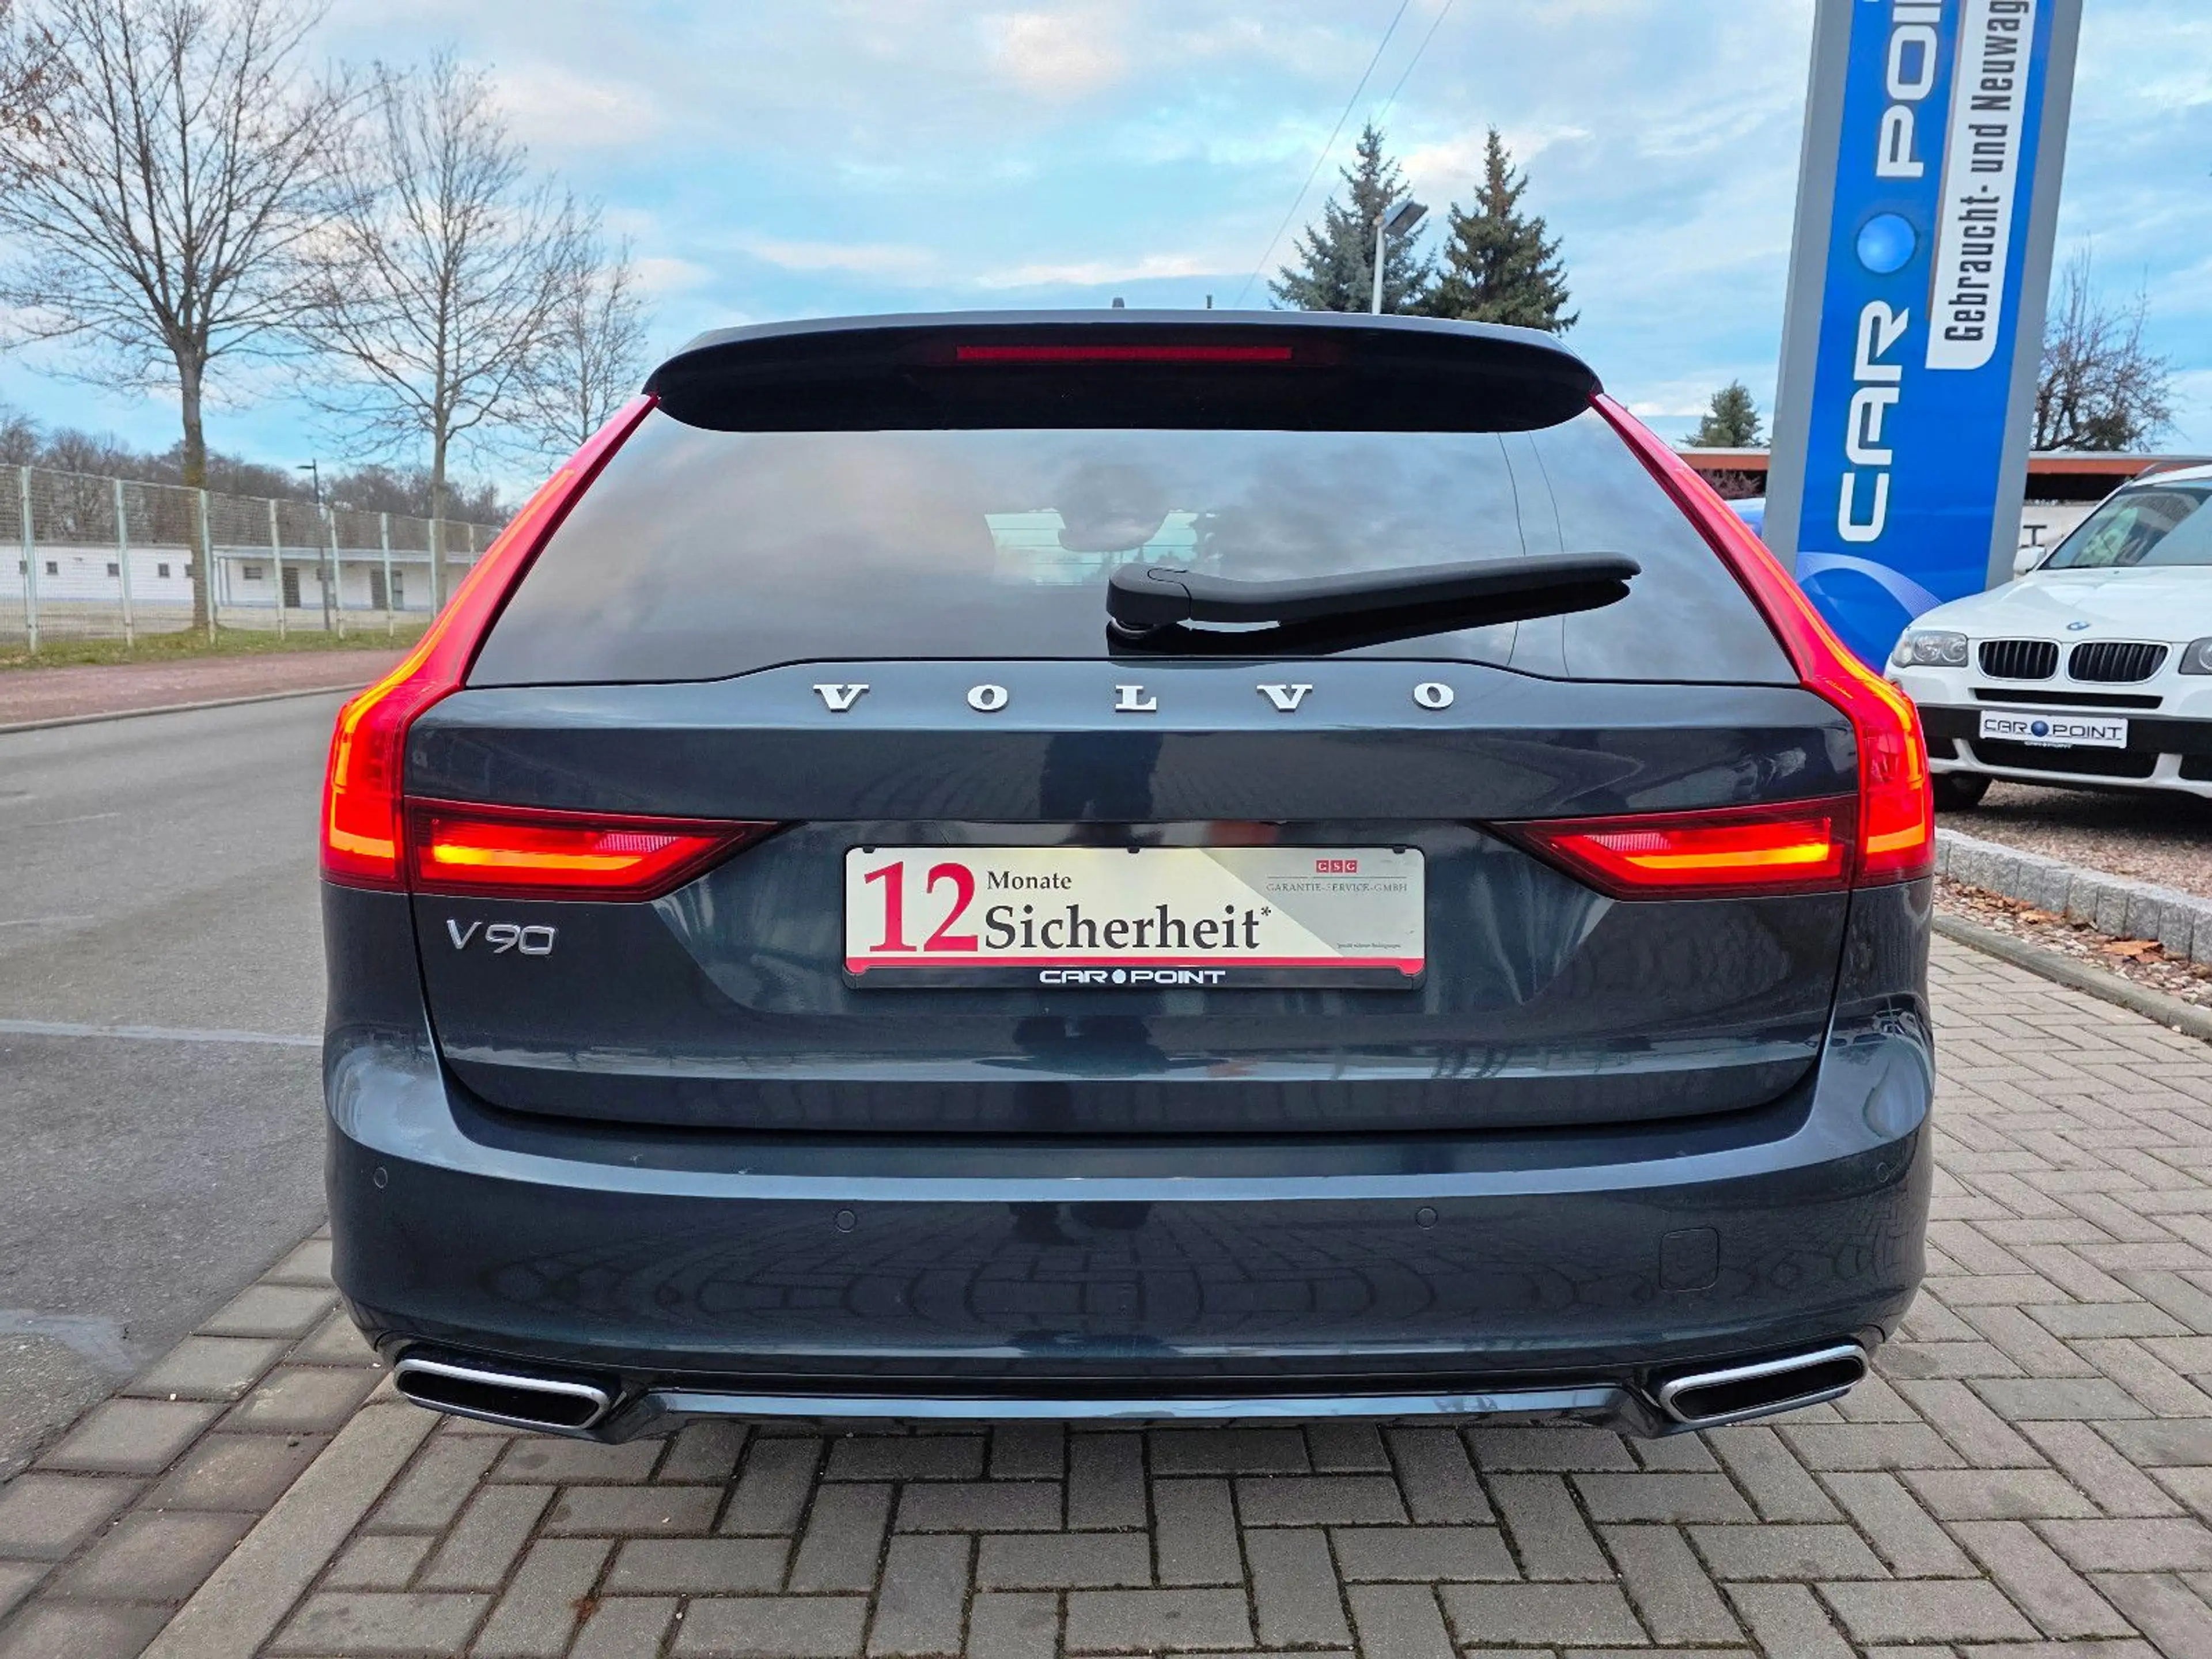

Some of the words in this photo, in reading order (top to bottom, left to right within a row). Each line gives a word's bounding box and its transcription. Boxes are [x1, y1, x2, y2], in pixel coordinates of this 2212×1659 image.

[1968, 123, 2008, 173] und
[1838, 300, 1910, 542] CAR
[1876, 0, 1942, 178] POI
[1945, 184, 2000, 342] Gebraucht-
[813, 683, 1454, 712] VOLVO
[1984, 719, 2028, 733] CAR
[2052, 724, 2123, 739] POINT
[987, 871, 1072, 891] Monate
[1317, 861, 1357, 873] GSG
[863, 861, 979, 953] 12
[446, 919, 556, 955] V90
[1039, 970, 1108, 984] CAR
[1131, 970, 1226, 984] POINT
